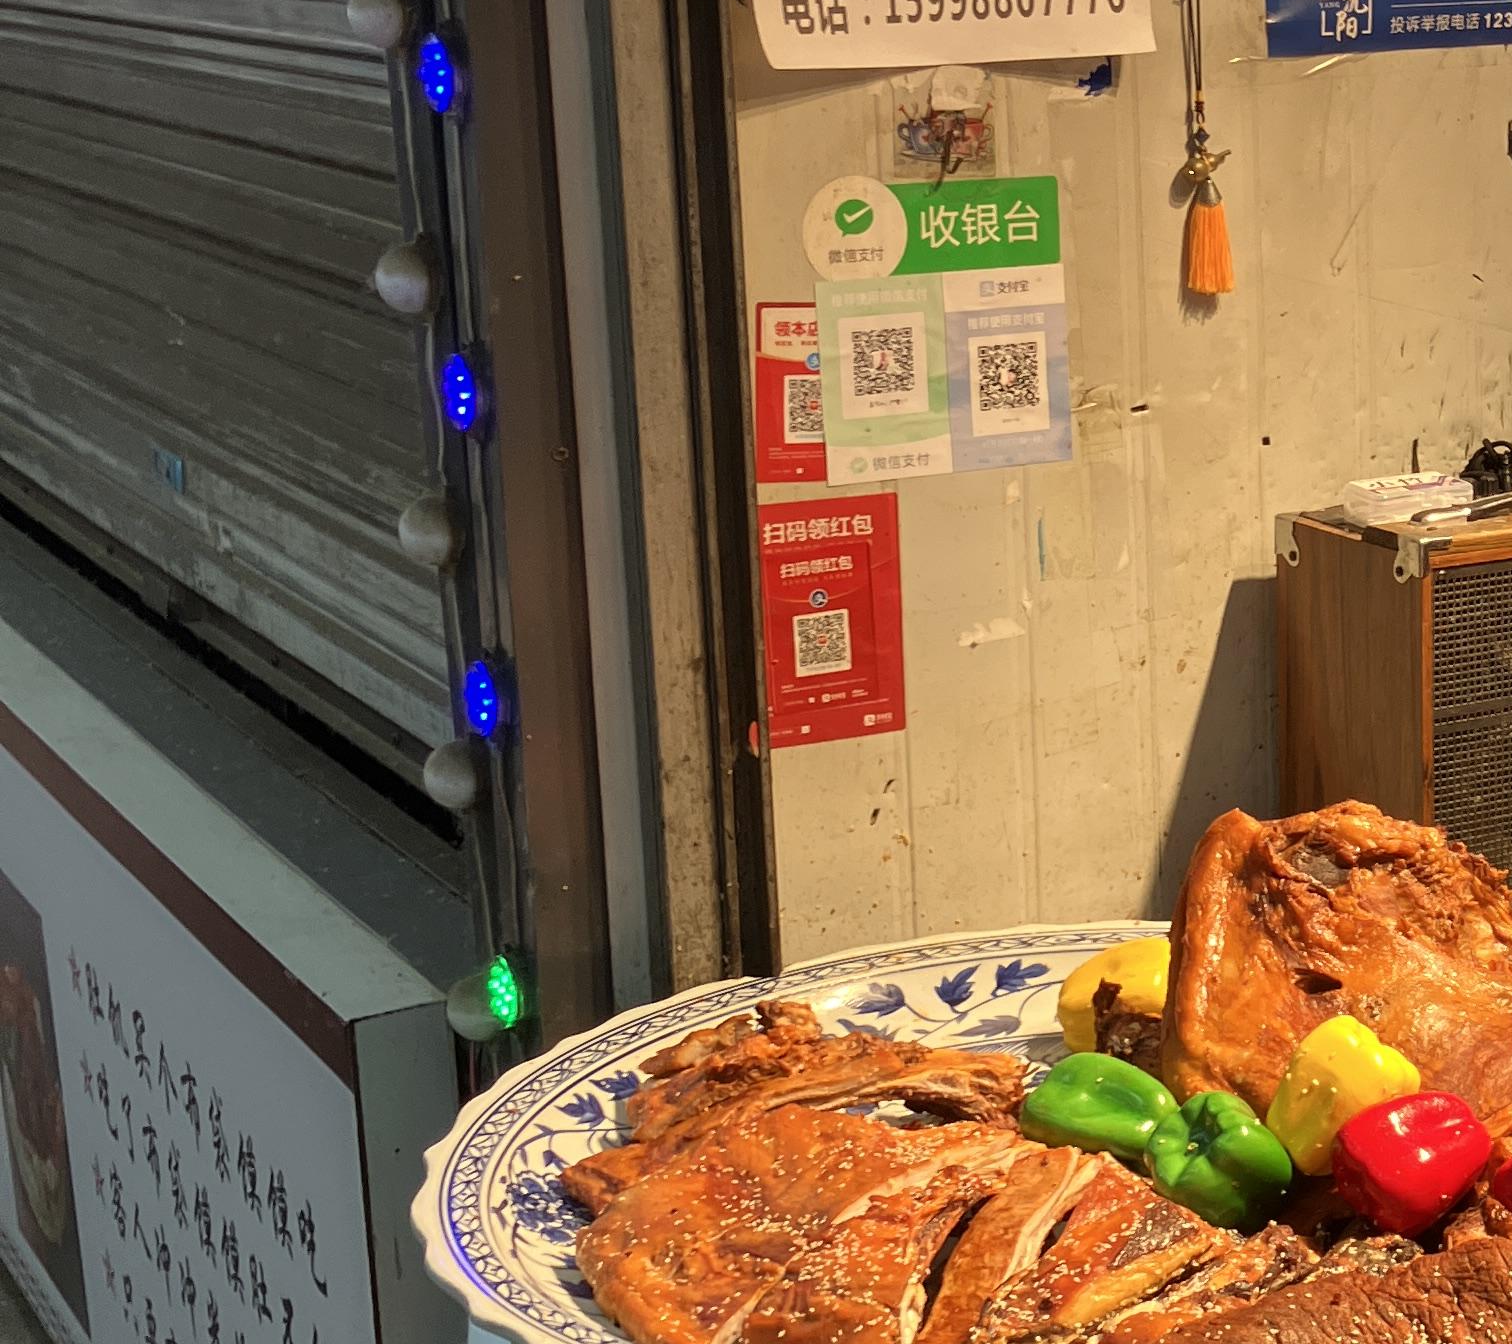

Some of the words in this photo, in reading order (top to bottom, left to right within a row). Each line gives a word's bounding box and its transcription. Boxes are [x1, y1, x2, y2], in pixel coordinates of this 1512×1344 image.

[920, 199, 1041, 249] 收银台
[828, 247, 885, 265] 微信支付
[996, 279, 1031, 295] 支付宝
[872, 451, 931, 472] 微信支付
[762, 513, 874, 547] 扫码领红包
[778, 554, 854, 580] 扫码领红包
